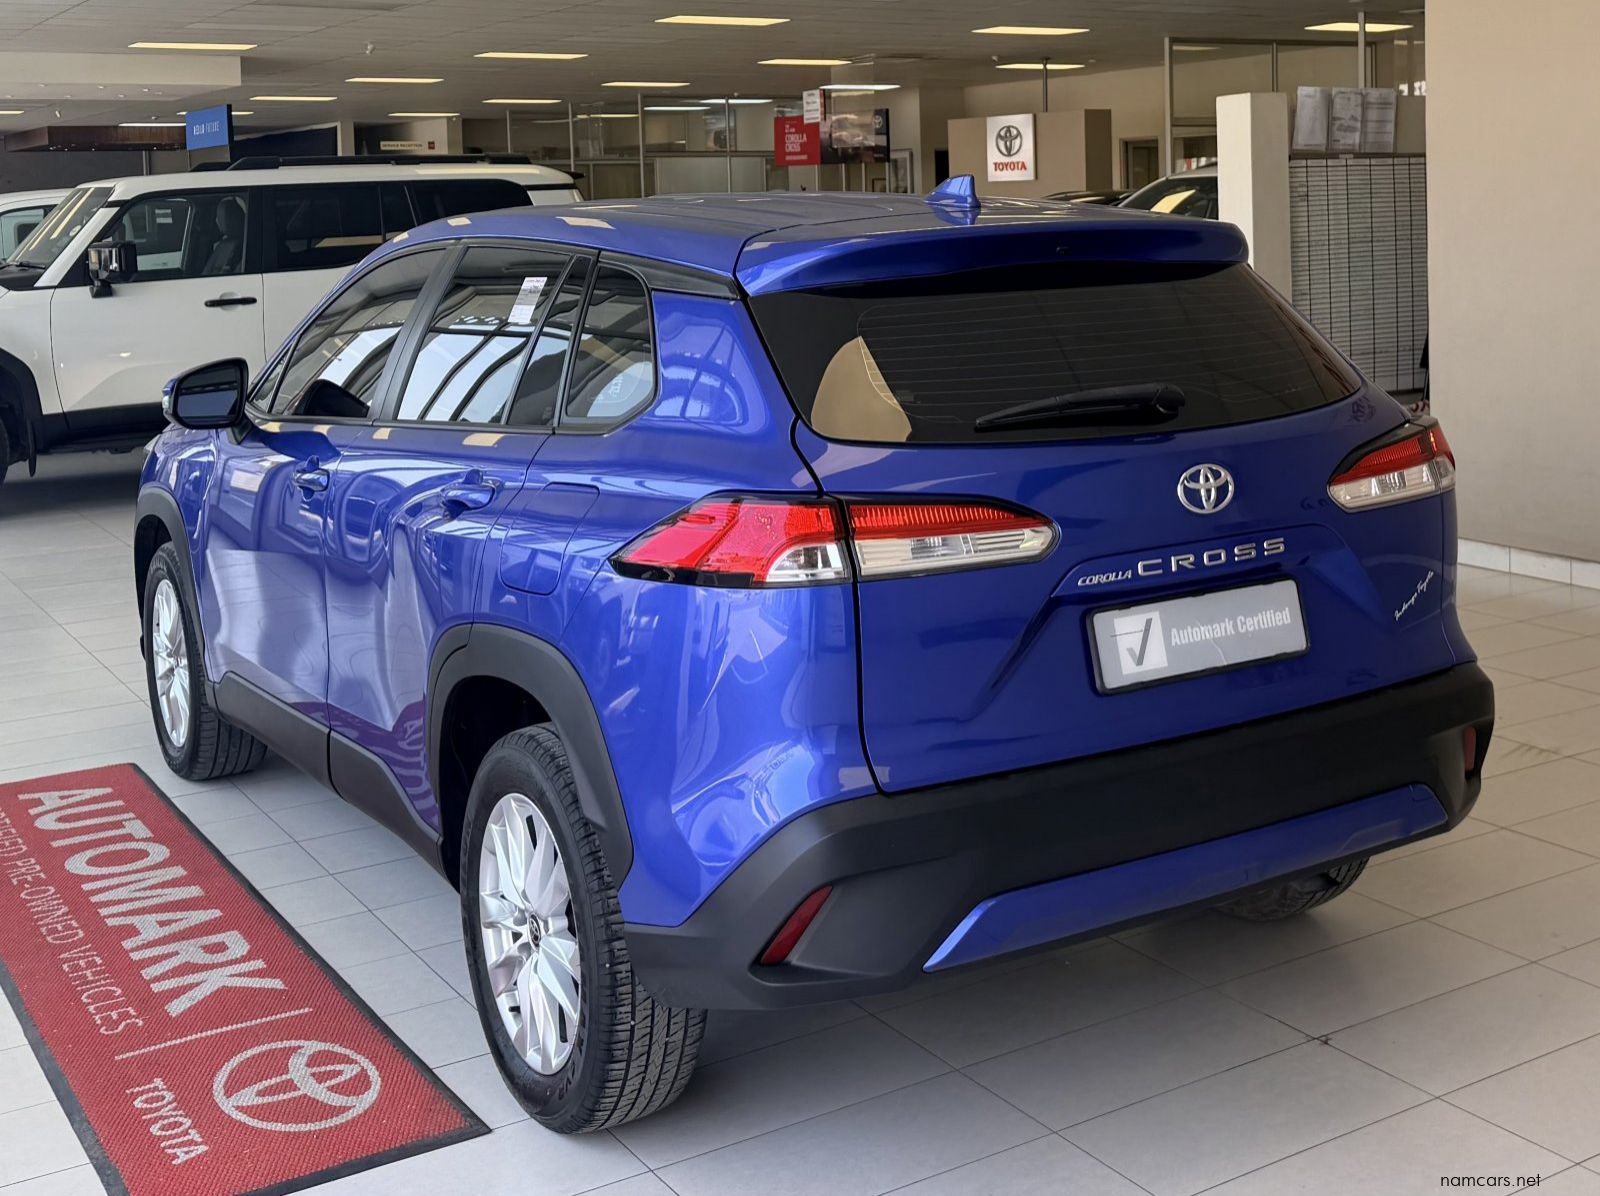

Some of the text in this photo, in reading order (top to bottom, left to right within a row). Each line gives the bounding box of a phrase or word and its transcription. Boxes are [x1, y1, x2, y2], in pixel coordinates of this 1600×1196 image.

[785, 133, 807, 143] COROLLA
[993, 161, 1027, 172] TOYOTA
[1077, 537, 1285, 587] COROLLA CROSS
[1170, 607, 1292, 647] Automark Certified
[18, 787, 286, 1017] AUTOMARK
[3, 857, 84, 944] PRE-OWNED
[58, 943, 144, 1035] VEHICLES
[126, 1076, 210, 1166] TOYOTA
